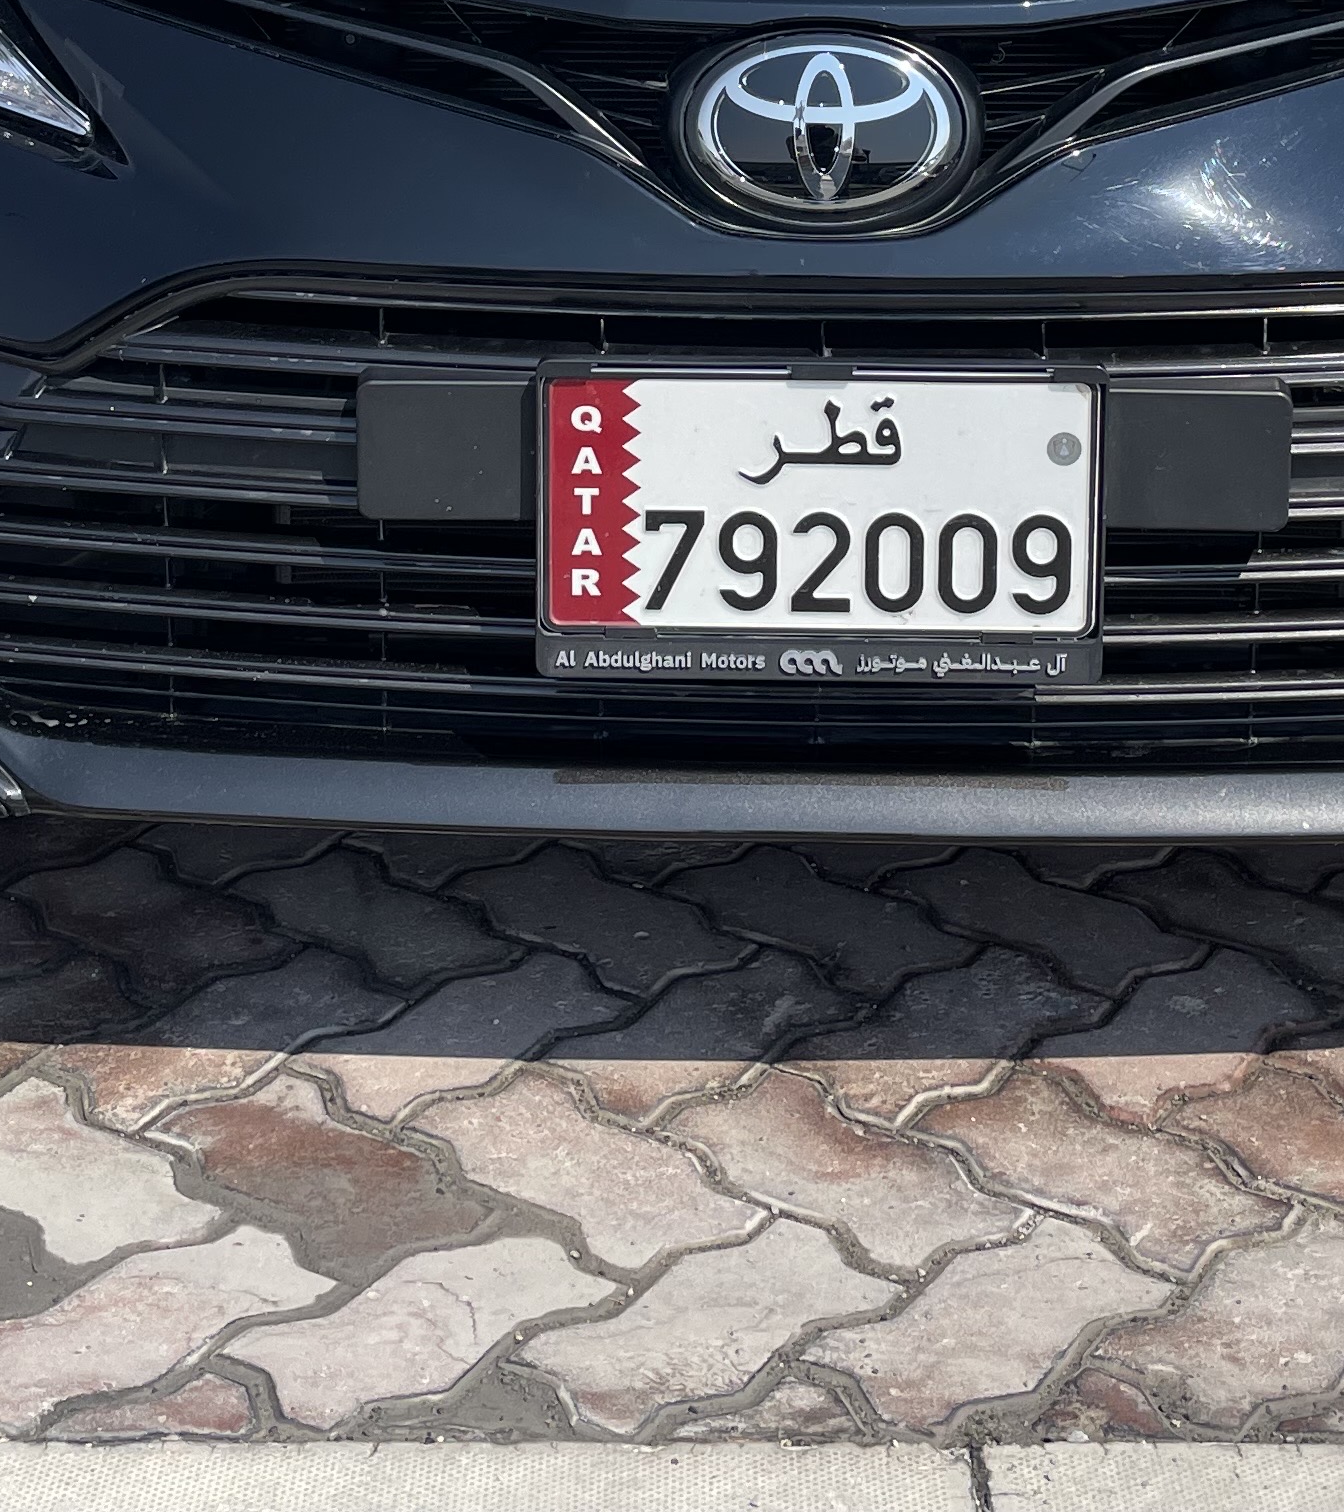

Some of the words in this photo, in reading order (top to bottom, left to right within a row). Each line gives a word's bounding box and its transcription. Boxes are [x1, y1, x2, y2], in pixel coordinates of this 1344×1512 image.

[737, 396, 902, 486] قطر
[570, 404, 603, 597] QATAR
[644, 510, 1072, 615] 792009
[555, 651, 576, 669] Al
[584, 650, 693, 674] Abdulghani
[701, 650, 766, 670] Motors
